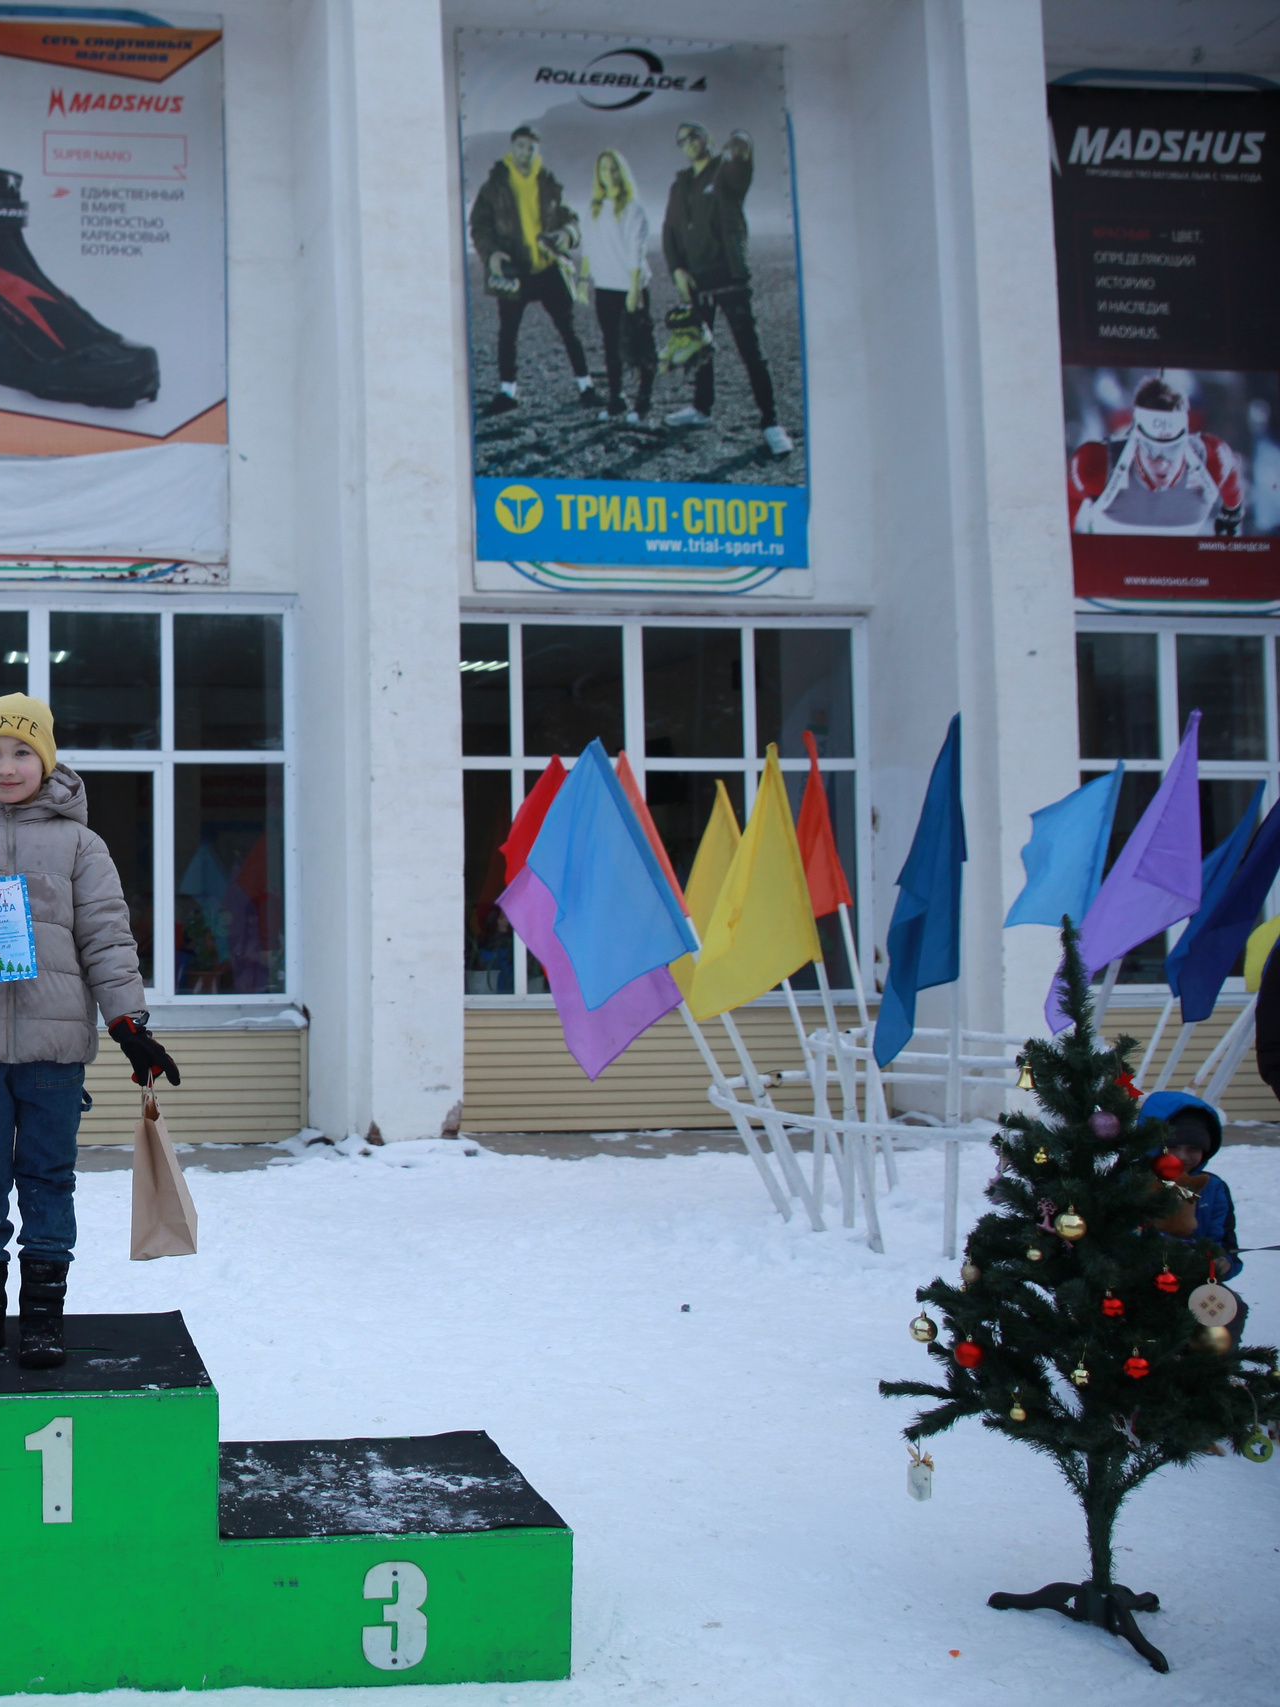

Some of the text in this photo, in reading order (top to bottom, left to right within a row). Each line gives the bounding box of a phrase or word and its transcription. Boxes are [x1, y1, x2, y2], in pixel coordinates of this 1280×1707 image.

[42, 36, 193, 50] сеть спортивных
[75, 51, 168, 62] магазинов
[70, 92, 184, 113] MADSHUS
[1068, 126, 1266, 165] MADSHUS
[94, 151, 132, 162] NANO
[80, 187, 184, 200] ЕДИНСТВЕННЫЙ
[92, 203, 126, 213] МИРЕ
[81, 216, 164, 229] ПОЛНОСТЬЮ
[81, 231, 170, 243] КАРБОНОВЫЙ
[81, 245, 143, 256] БОТИНОК
[1095, 276, 1156, 290] ИСТОРИЮ
[646, 538, 784, 556] www.trial-sport.ru
[25, 1416, 73, 1523] 1
[362, 1561, 428, 1671] 3
